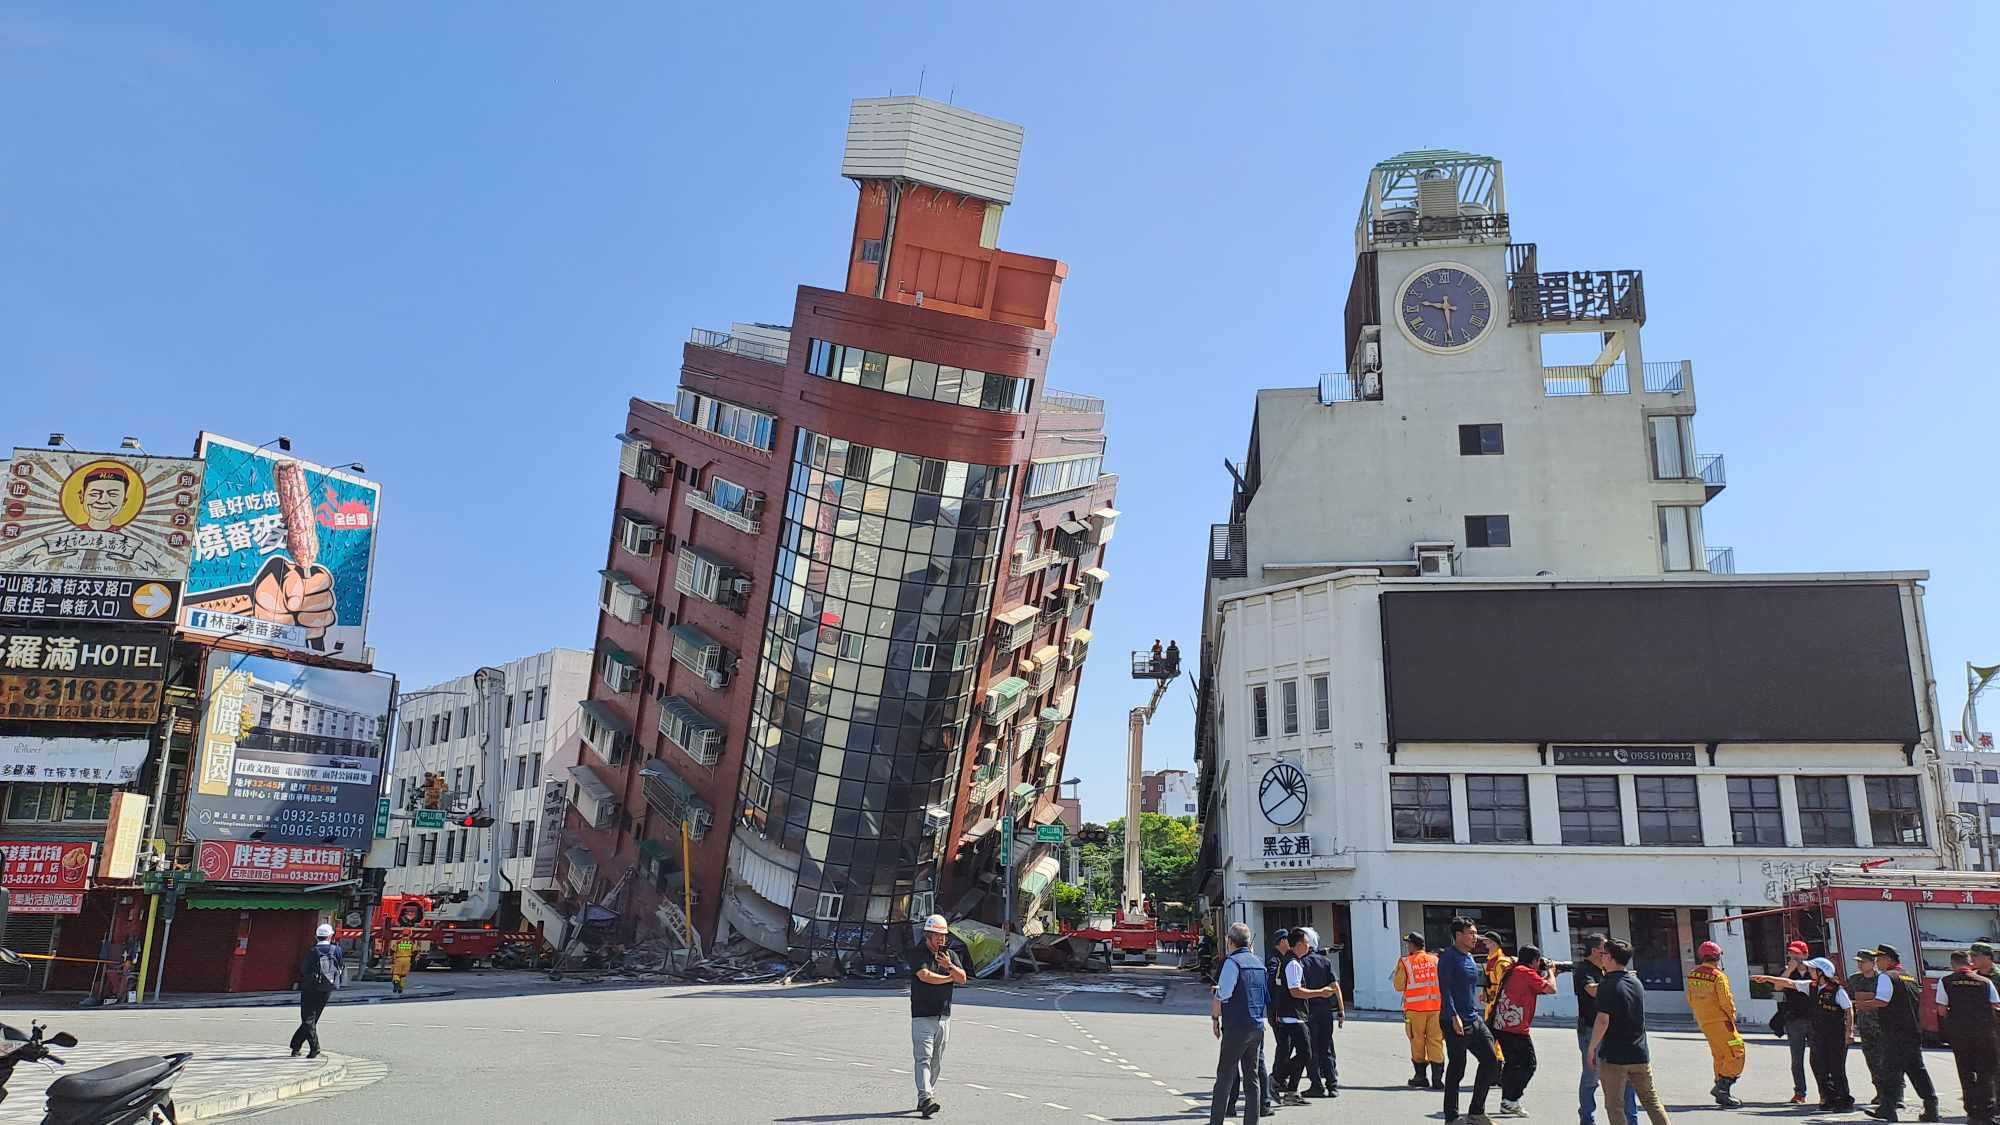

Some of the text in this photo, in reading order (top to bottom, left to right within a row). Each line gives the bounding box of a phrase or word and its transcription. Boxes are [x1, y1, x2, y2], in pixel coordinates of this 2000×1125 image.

[207, 491, 281, 518] 最好吃的
[192, 513, 289, 562] 燒番麥
[0, 635, 163, 671] 羅滿 HOTEL
[0, 677, 158, 704] -8316622
[282, 809, 365, 825] 0932-581018
[280, 823, 363, 839] 0905-935071
[0, 845, 62, 862] 爹美式炸雞
[1263, 835, 1311, 857] 黑金通
[2, 874, 57, 884] 03-8327130
[290, 871, 339, 881] 03-8327130
